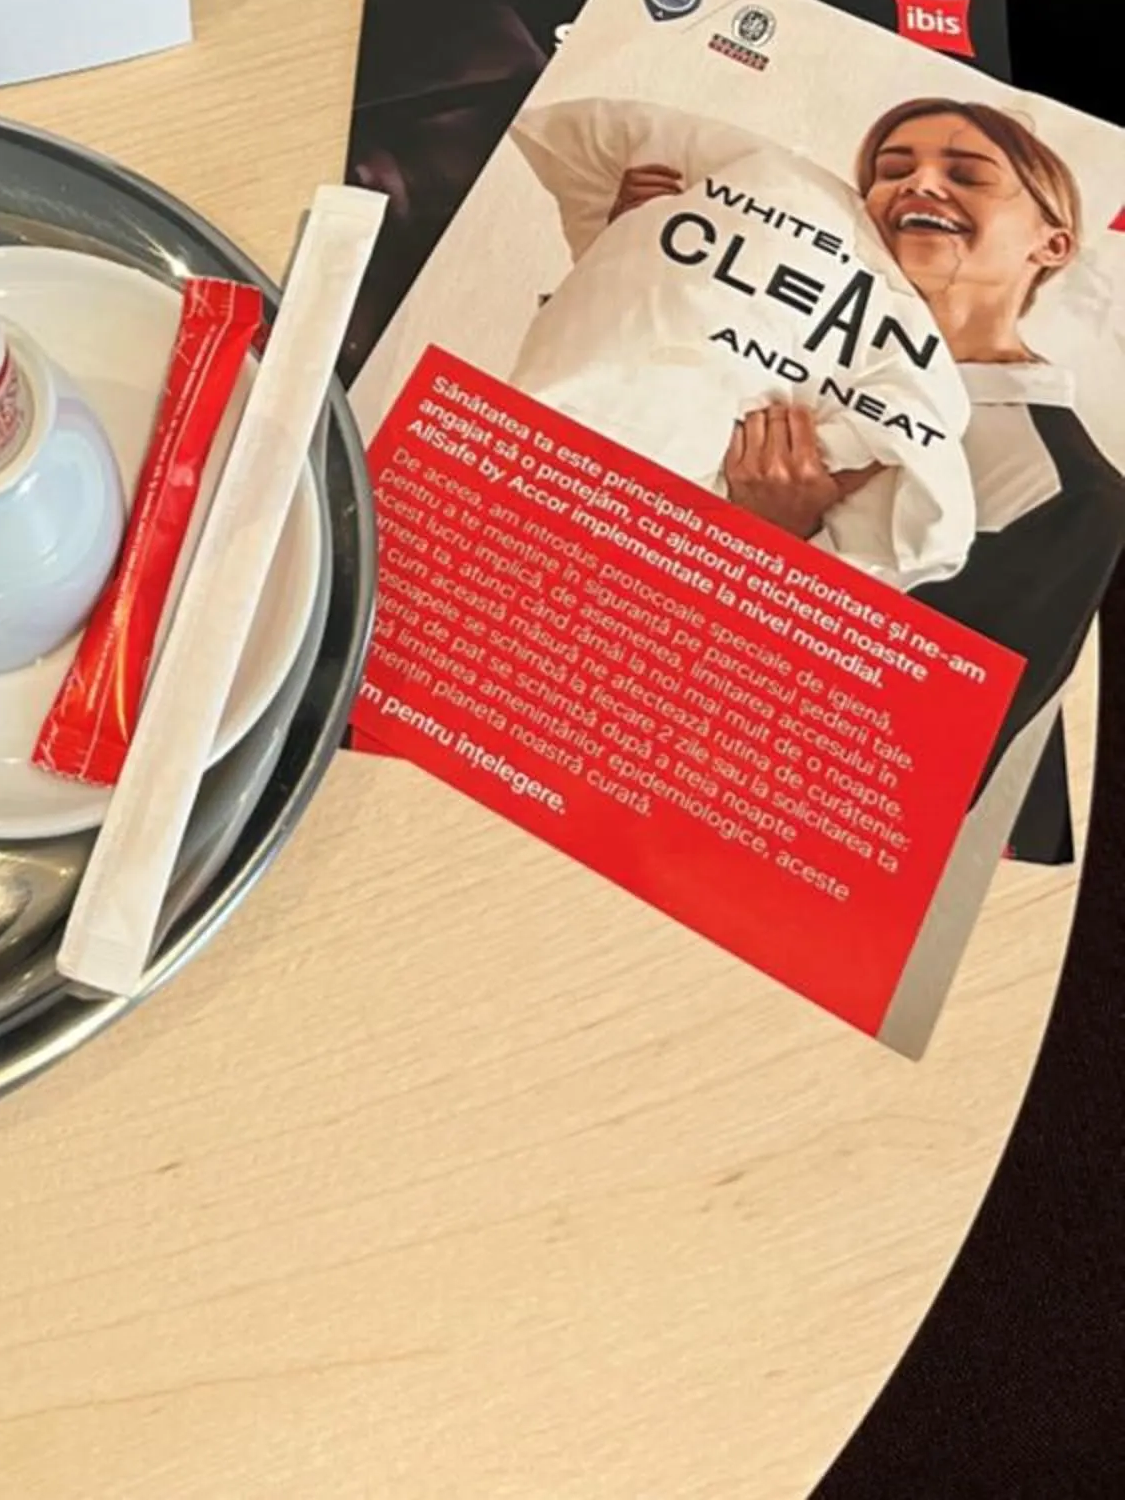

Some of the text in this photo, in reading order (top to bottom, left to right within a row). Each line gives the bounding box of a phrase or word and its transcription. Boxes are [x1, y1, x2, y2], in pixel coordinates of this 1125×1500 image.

[906, 5, 962, 37] ibis
[705, 176, 850, 263] WHITE,
[660, 212, 940, 370] CLEAN
[709, 327, 946, 449] AND NEAT
[408, 420, 882, 687] AllSafe by Accor implementate la nivel mondial.
[419, 400, 493, 446] angajat
[521, 455, 535, 469] o
[638, 516, 664, 538] cu
[666, 532, 746, 581] ajutorul
[747, 576, 843, 634] etichetei
[843, 628, 927, 680] noastre
[534, 432, 553, 452] ta
[557, 447, 602, 477] este
[602, 471, 702, 531] principala
[784, 568, 885, 628] prioritate
[910, 634, 985, 682] ne-am
[381, 697, 454, 746] pentru
